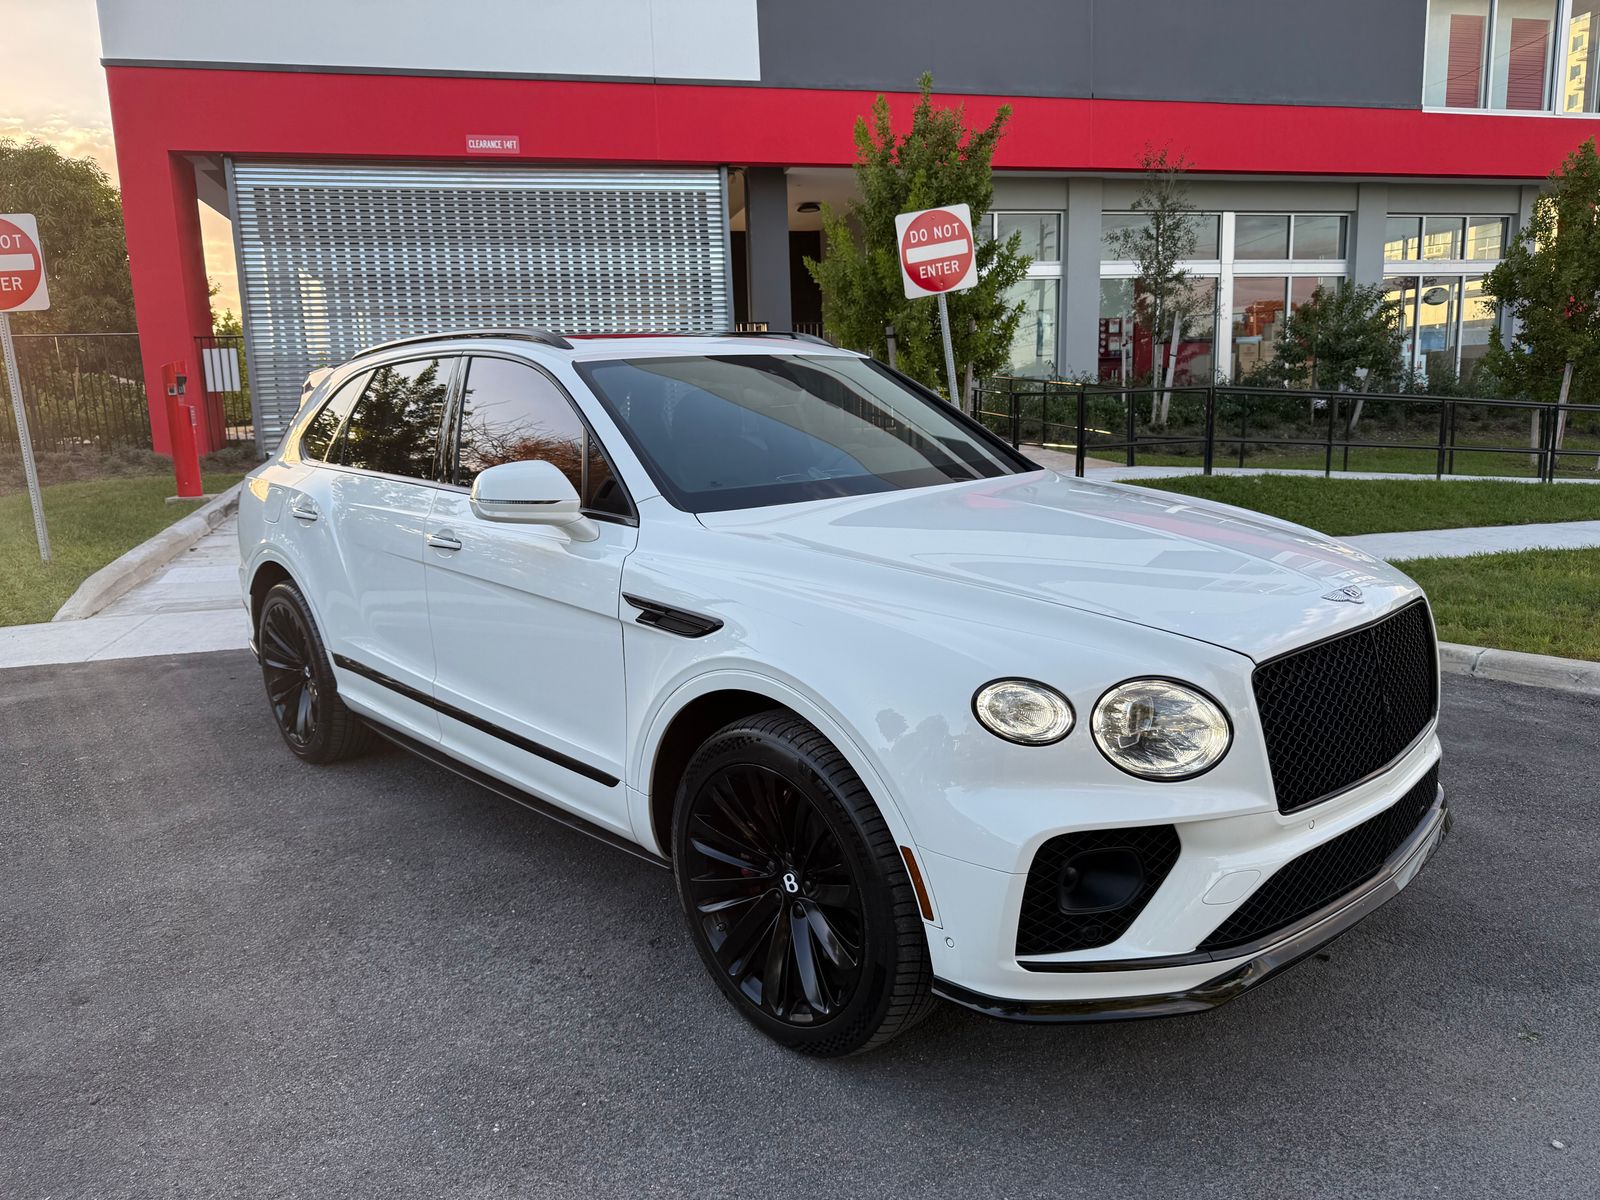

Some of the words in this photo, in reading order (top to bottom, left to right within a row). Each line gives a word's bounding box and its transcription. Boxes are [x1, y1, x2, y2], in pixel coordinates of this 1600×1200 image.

[468, 139, 502, 149] CLEARANCE
[503, 140, 517, 149] 14FT
[909, 228, 928, 244] DO
[933, 222, 960, 240] NOT
[919, 260, 960, 279] ENTER
[782, 873, 799, 893] B
